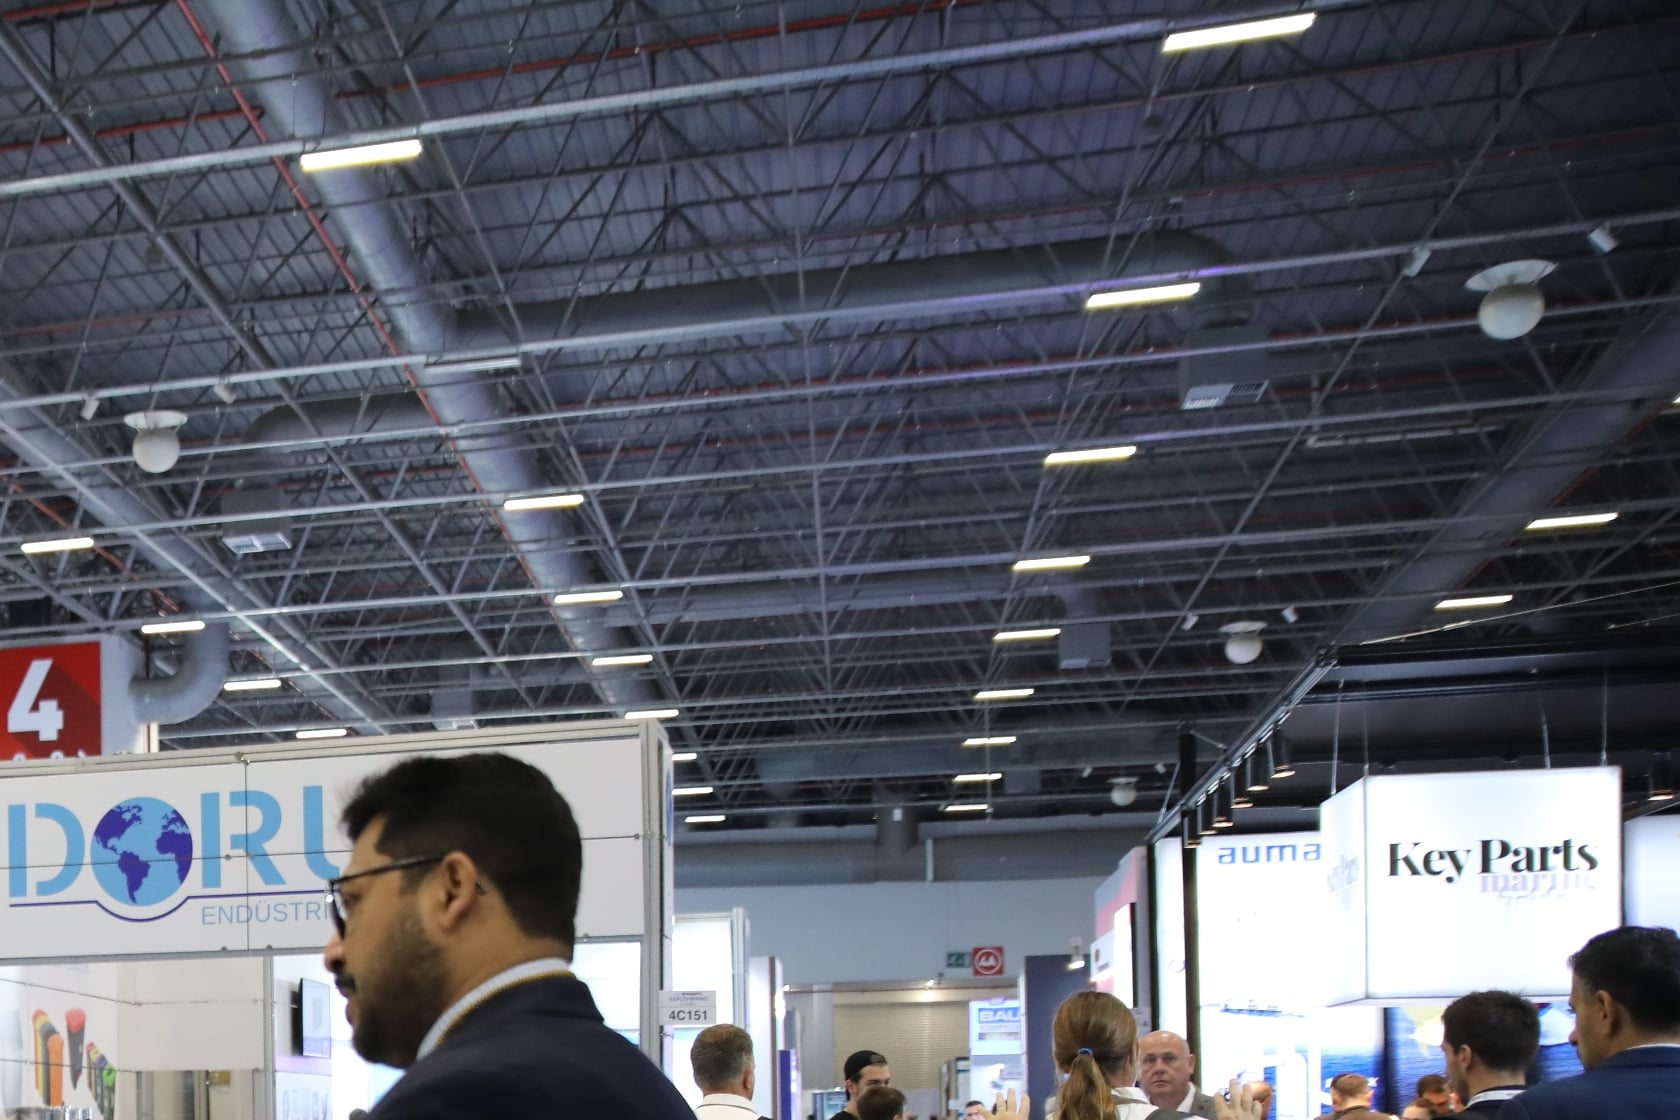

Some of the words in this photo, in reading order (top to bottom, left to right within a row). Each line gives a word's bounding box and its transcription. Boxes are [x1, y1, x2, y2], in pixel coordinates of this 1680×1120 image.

[7, 659, 63, 741] 4
[1218, 843, 1320, 865] auma
[1388, 842, 1472, 884] Key
[1477, 838, 1599, 874] Parts
[669, 1010, 708, 1021] 4C151
